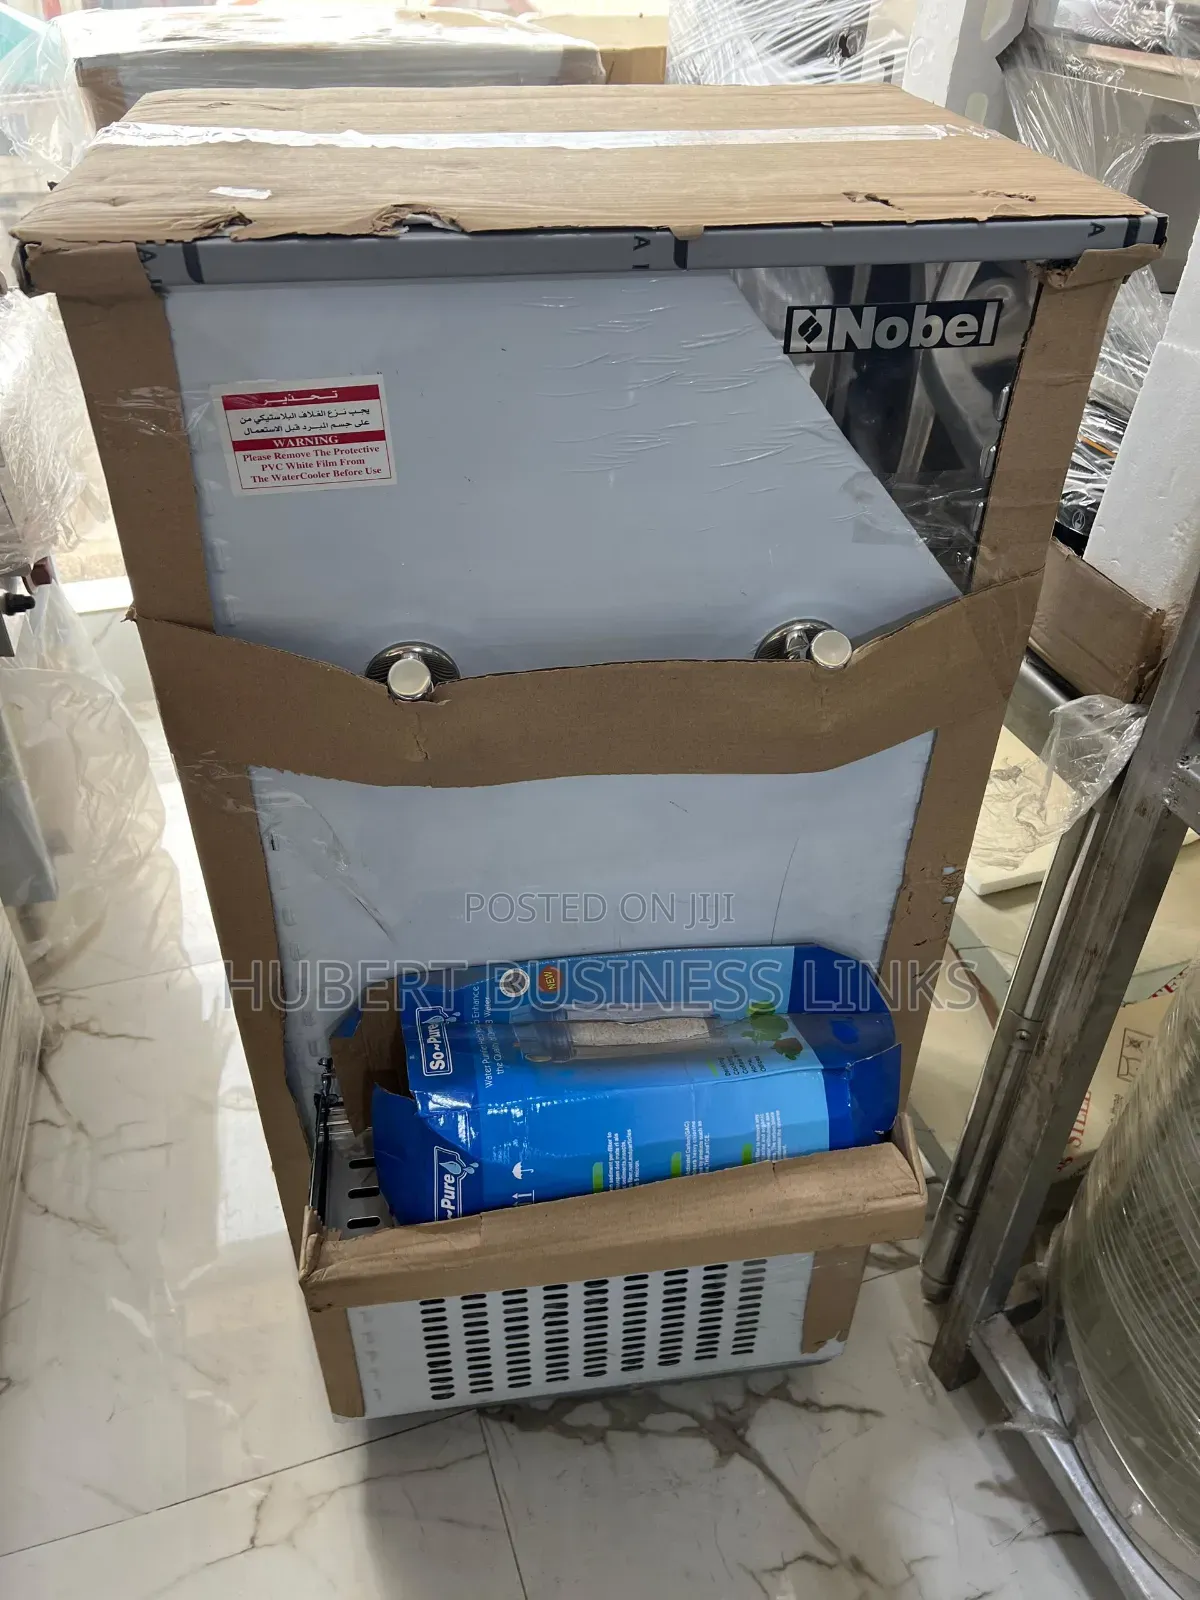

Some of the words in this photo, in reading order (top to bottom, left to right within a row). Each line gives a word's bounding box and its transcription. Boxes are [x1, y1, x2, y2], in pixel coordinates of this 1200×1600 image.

[831, 301, 1000, 351] Nobel
[273, 436, 338, 448] WARNING
[243, 454, 271, 462] Please
[334, 446, 380, 455] Protective
[261, 463, 282, 472] PVC
[271, 471, 330, 481] WaterCooler
[333, 469, 362, 478] Before
[544, 971, 556, 990] NEW
[496, 1062, 504, 1074] the
[484, 1065, 493, 1088] Water
